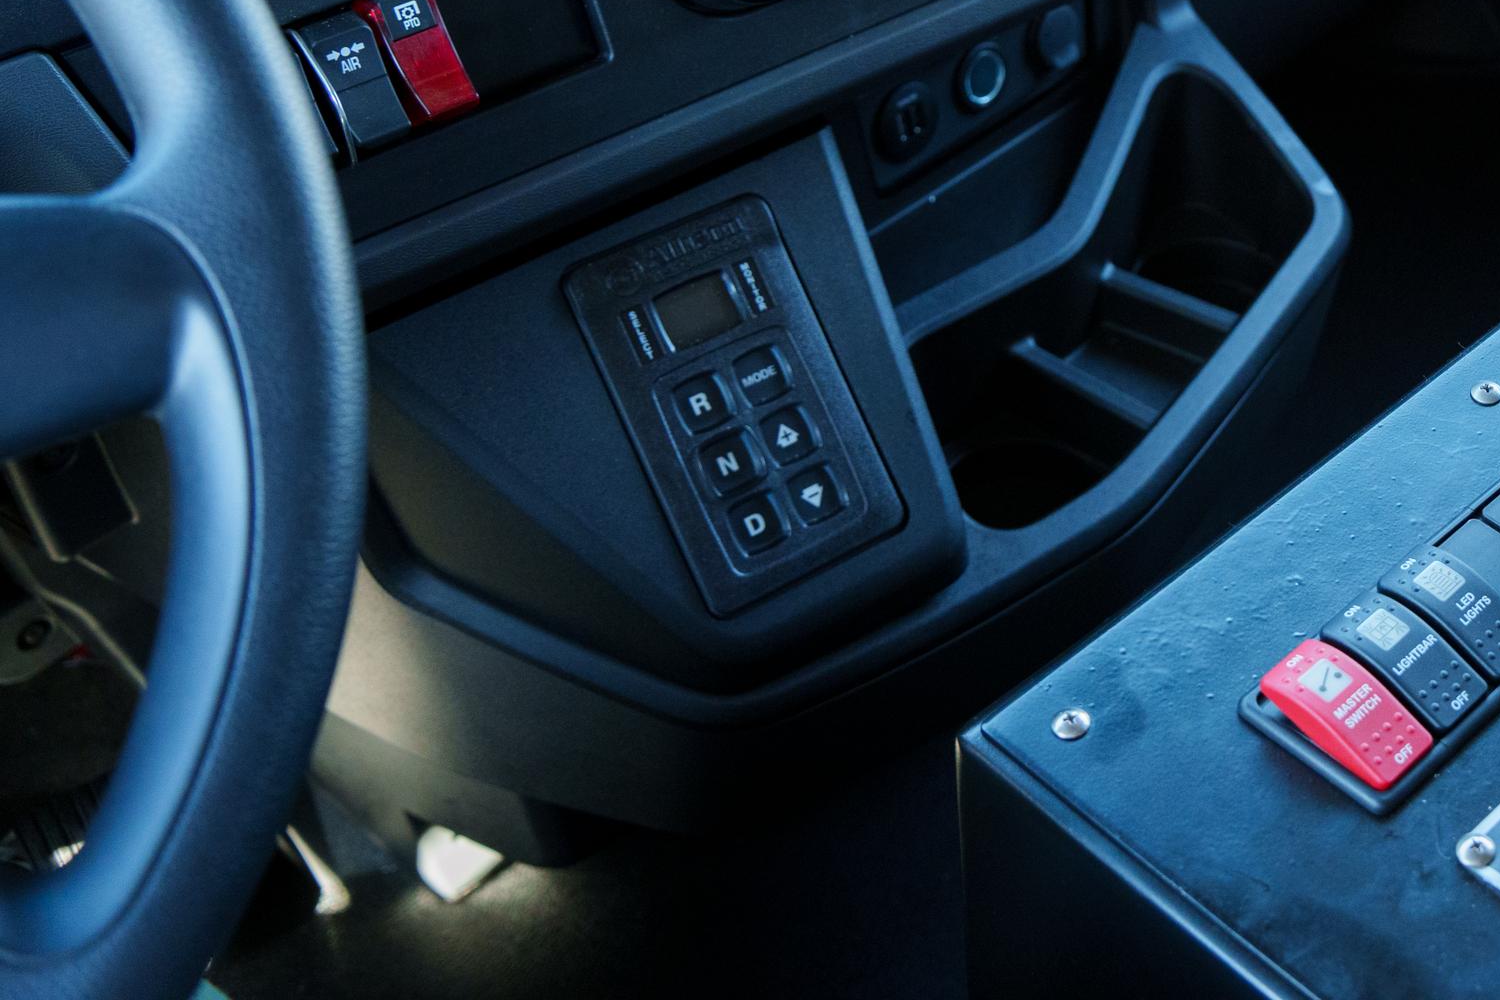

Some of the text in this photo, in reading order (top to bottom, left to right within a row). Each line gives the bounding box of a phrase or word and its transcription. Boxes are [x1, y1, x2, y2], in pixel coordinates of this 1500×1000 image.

[403, 16, 421, 30] PTO
[341, 56, 362, 74] AIR
[741, 365, 777, 388] MODE
[689, 392, 712, 417] R
[716, 451, 740, 477] N
[744, 512, 766, 537] D
[1400, 557, 1417, 571] ON
[1344, 604, 1361, 618] ON
[1455, 592, 1475, 611] LED
[1459, 595, 1492, 626] LIGHTS
[1286, 654, 1304, 668] ON
[1392, 634, 1438, 676] LIGHTBAR
[1333, 683, 1374, 720] MASTER
[1344, 693, 1382, 729] SWITCH
[1451, 691, 1471, 711] OFF
[1394, 743, 1414, 764] OFF
